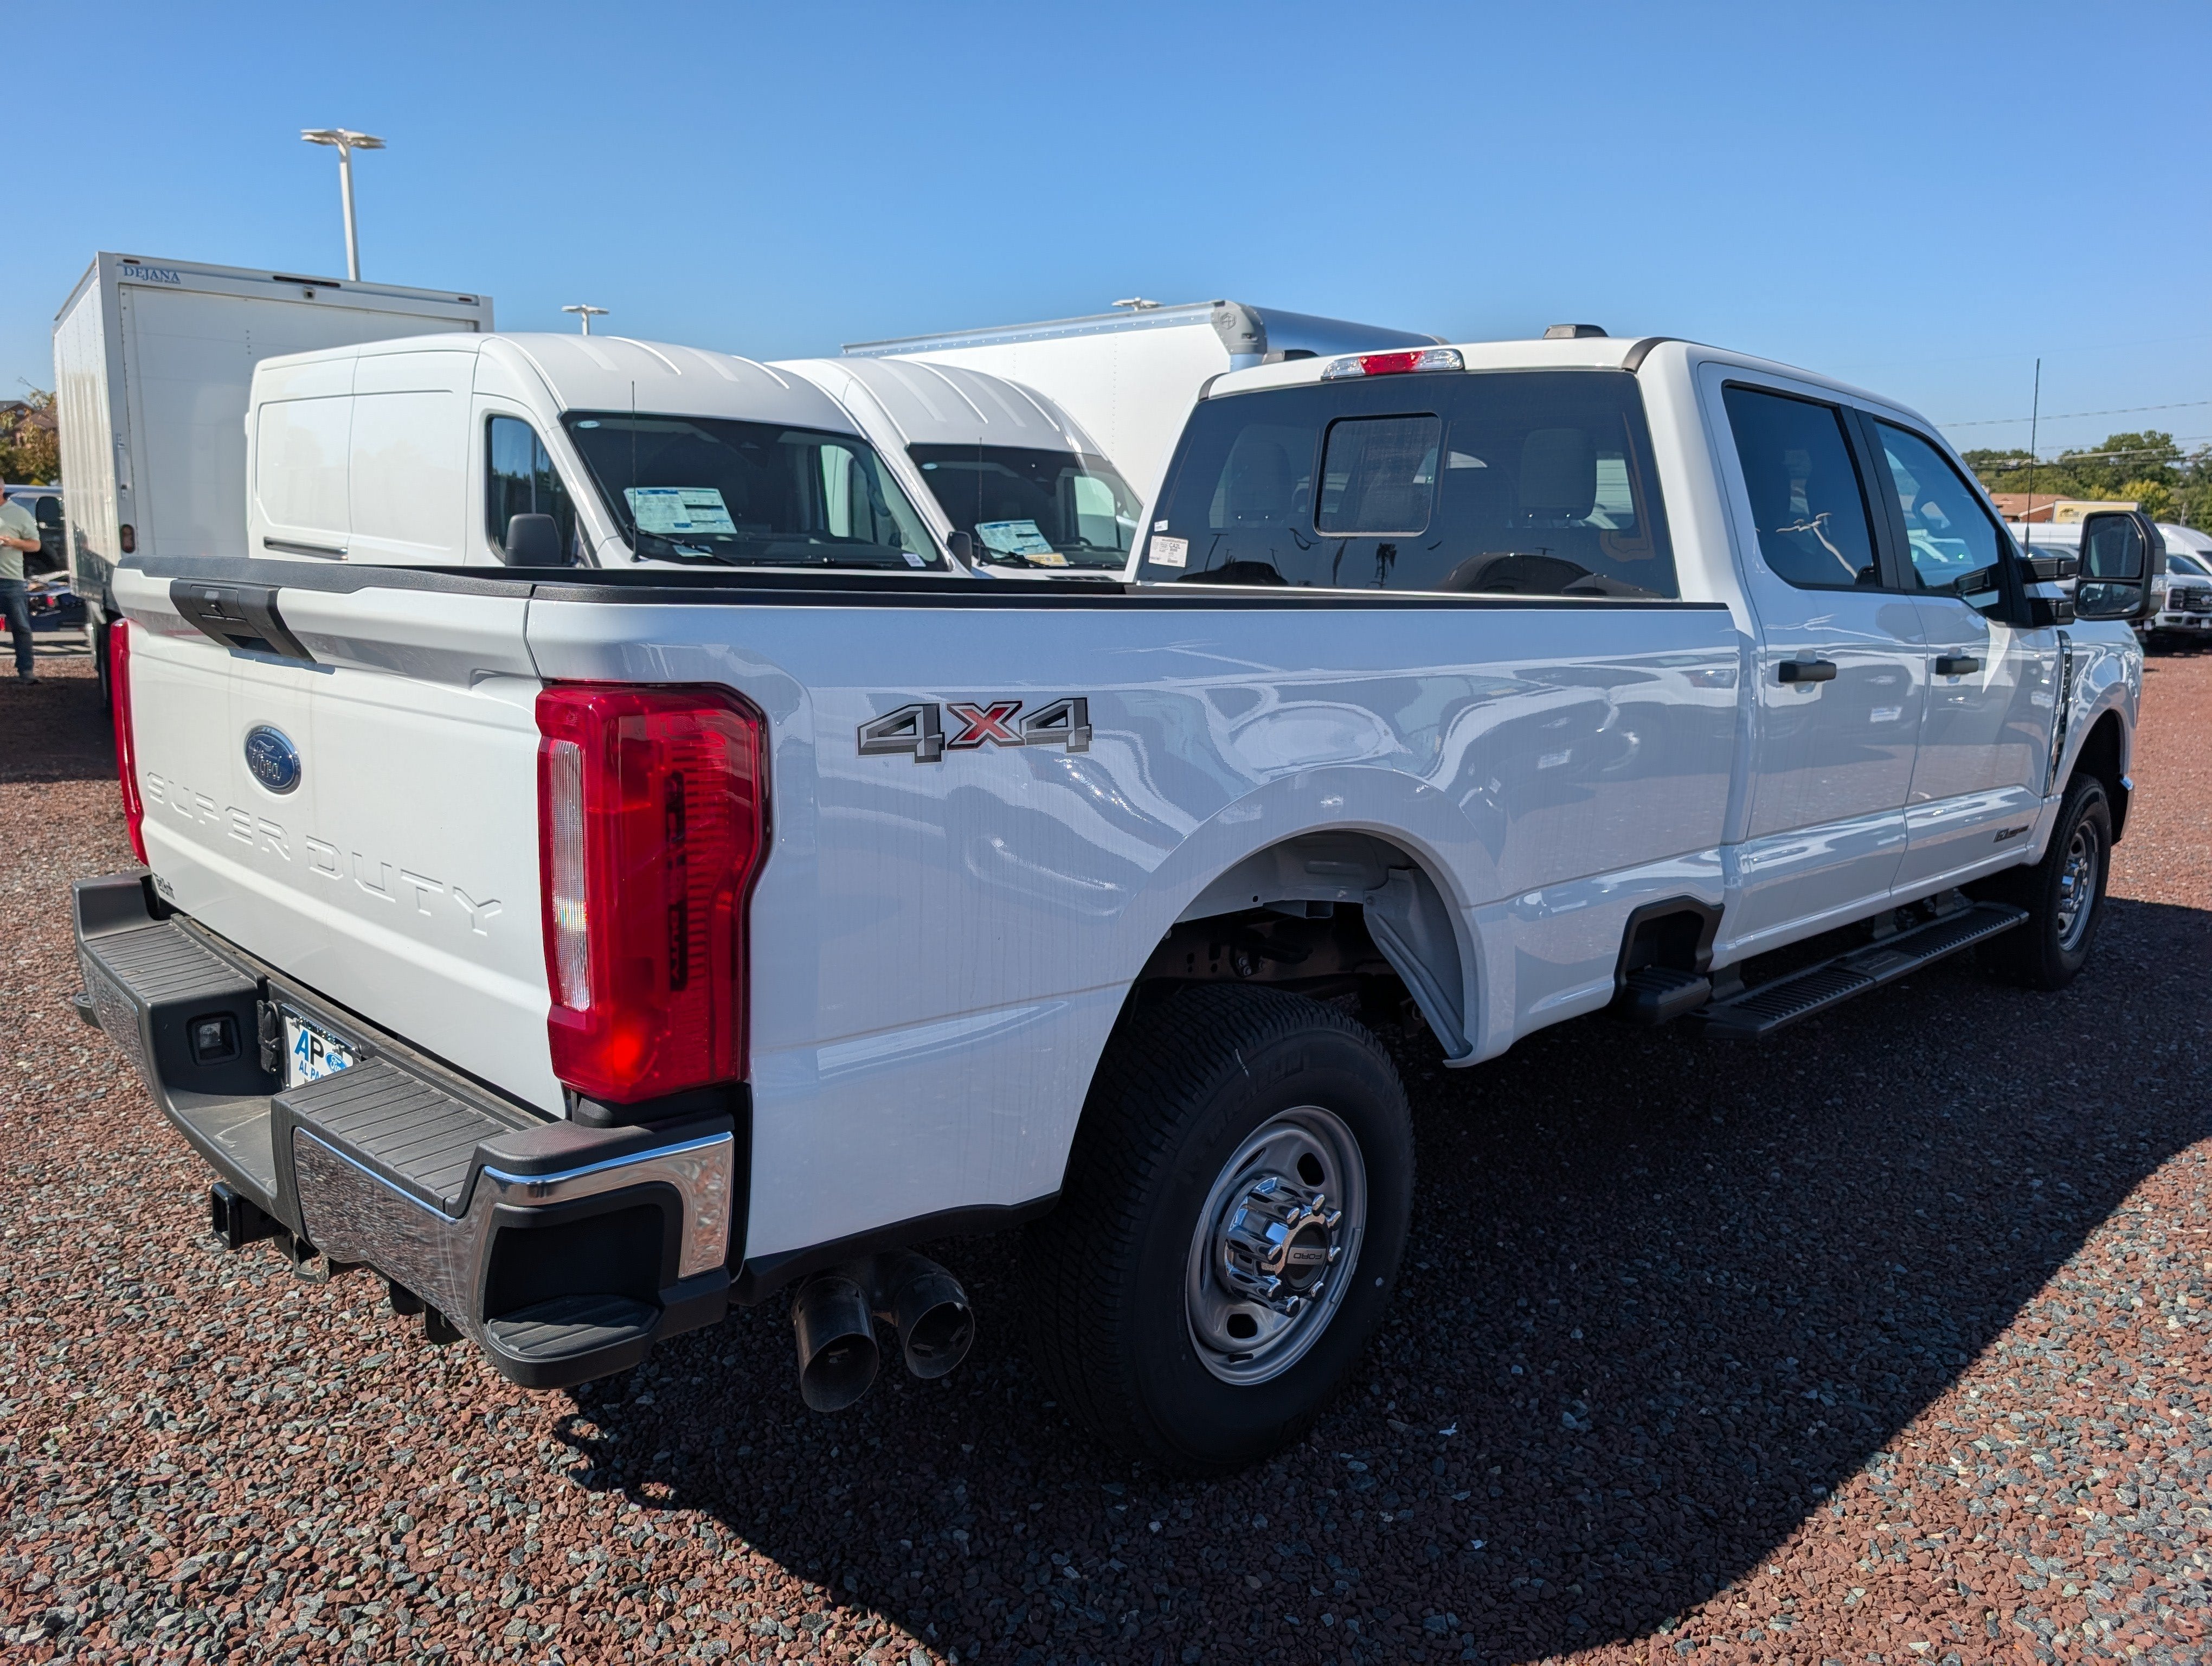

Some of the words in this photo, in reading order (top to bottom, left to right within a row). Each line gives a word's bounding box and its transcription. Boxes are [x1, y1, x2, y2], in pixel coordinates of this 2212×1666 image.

[124, 266, 181, 282] DEJANA
[856, 696, 1092, 764] 4X4
[249, 738, 282, 781] Ford
[146, 771, 291, 861] SUPER
[306, 835, 501, 937] DUTY
[294, 1029, 324, 1066] AP
[299, 1060, 308, 1077] AL
